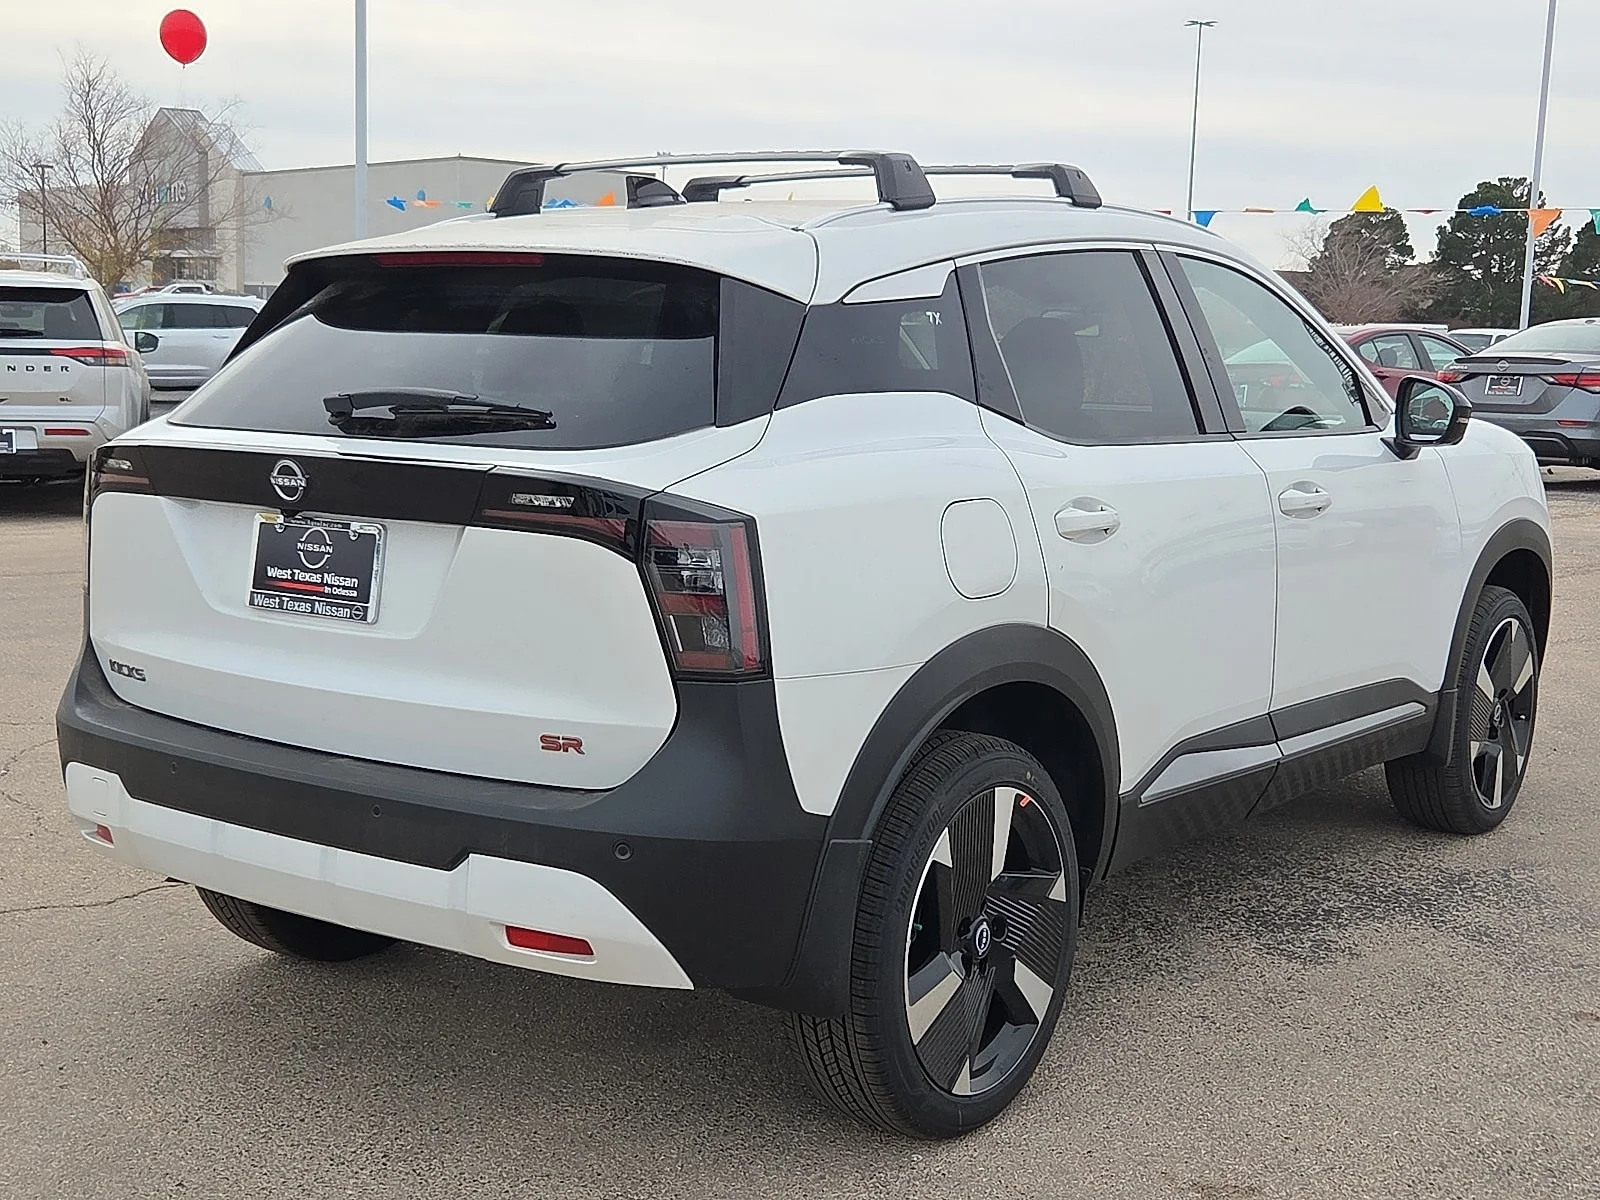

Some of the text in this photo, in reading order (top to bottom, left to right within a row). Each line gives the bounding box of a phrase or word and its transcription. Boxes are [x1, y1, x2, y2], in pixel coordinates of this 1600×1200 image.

[7, 365, 70, 373] NDER
[270, 475, 307, 488] NISSAN
[297, 542, 333, 554] NISSAN
[266, 566, 359, 588] West Texas Nissan
[333, 586, 358, 598] Odessa
[253, 594, 351, 618] West Texas Nissan
[109, 659, 147, 682] KICKS
[540, 734, 586, 755] SR
